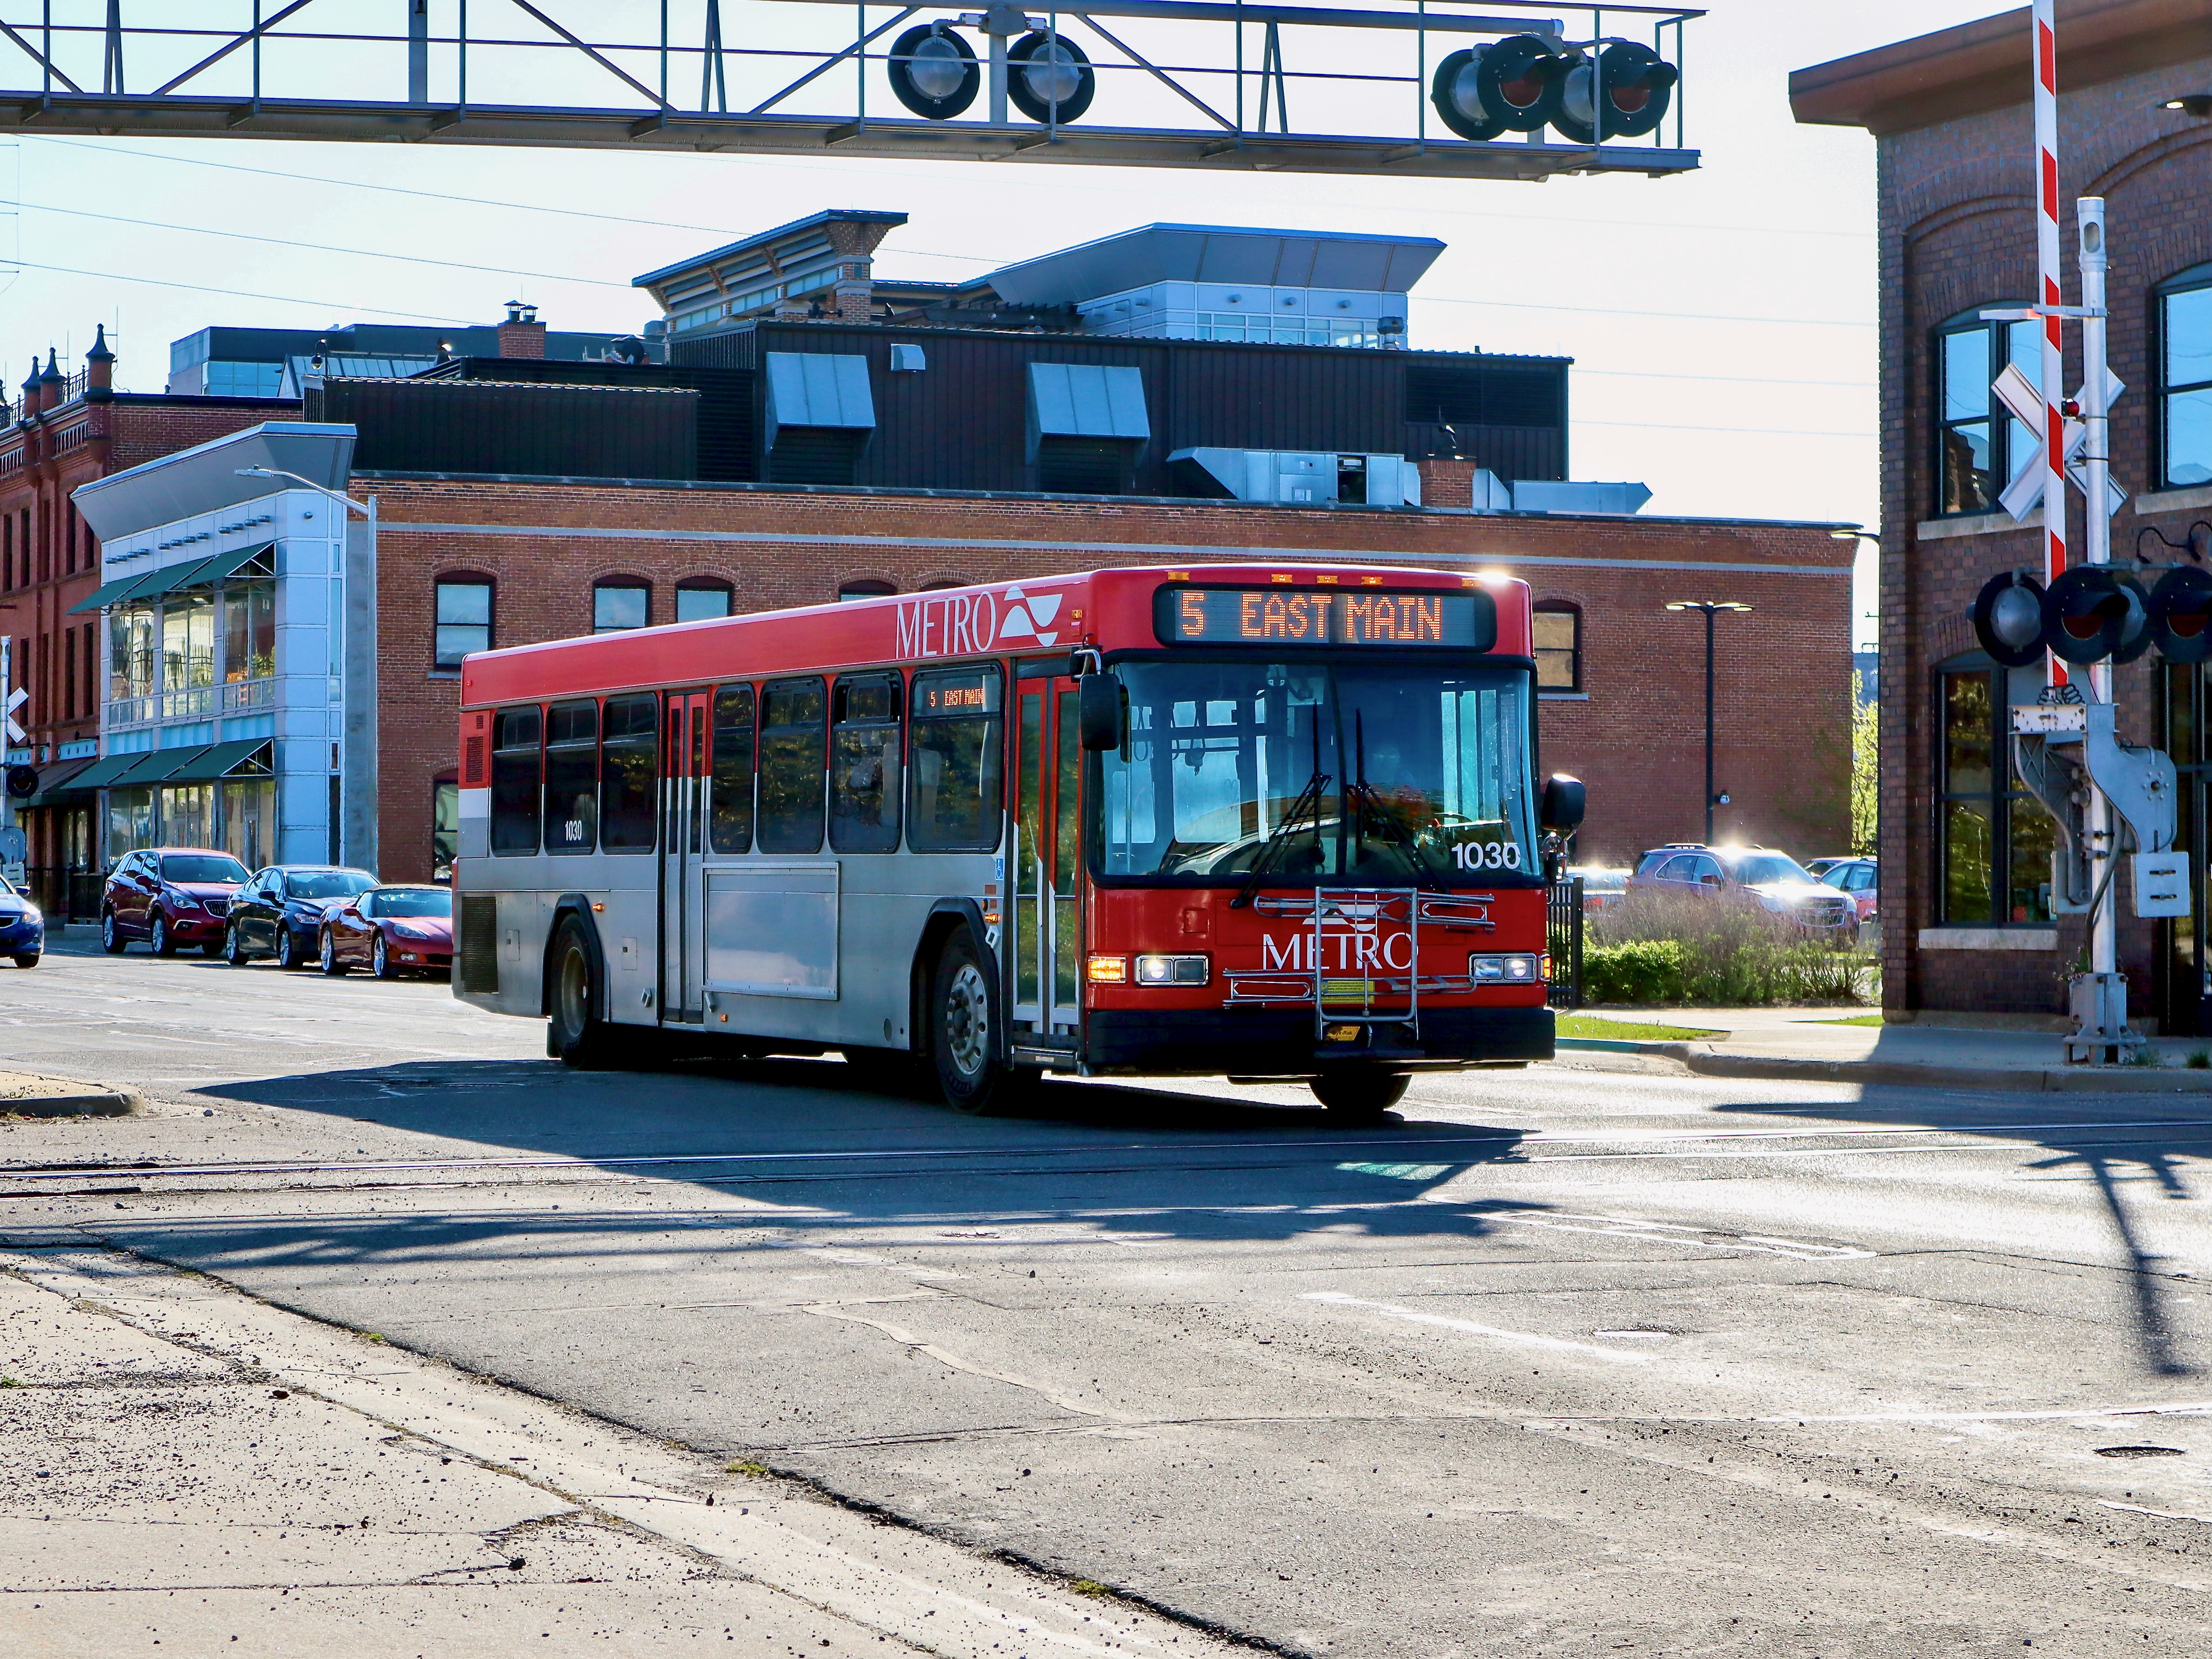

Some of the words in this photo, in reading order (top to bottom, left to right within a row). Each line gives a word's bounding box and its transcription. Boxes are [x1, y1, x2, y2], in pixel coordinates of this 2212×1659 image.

[896, 591, 996, 659] METRO
[1182, 592, 1205, 636] 5
[1241, 593, 1332, 638] EAST
[1346, 595, 1441, 640] MAIN
[930, 691, 936, 707] 5
[944, 689, 963, 706] EAST
[964, 688, 984, 705] MAIN
[565, 820, 582, 841] 1030
[1451, 842, 1521, 870] 1030
[1263, 932, 1419, 970] METRO
